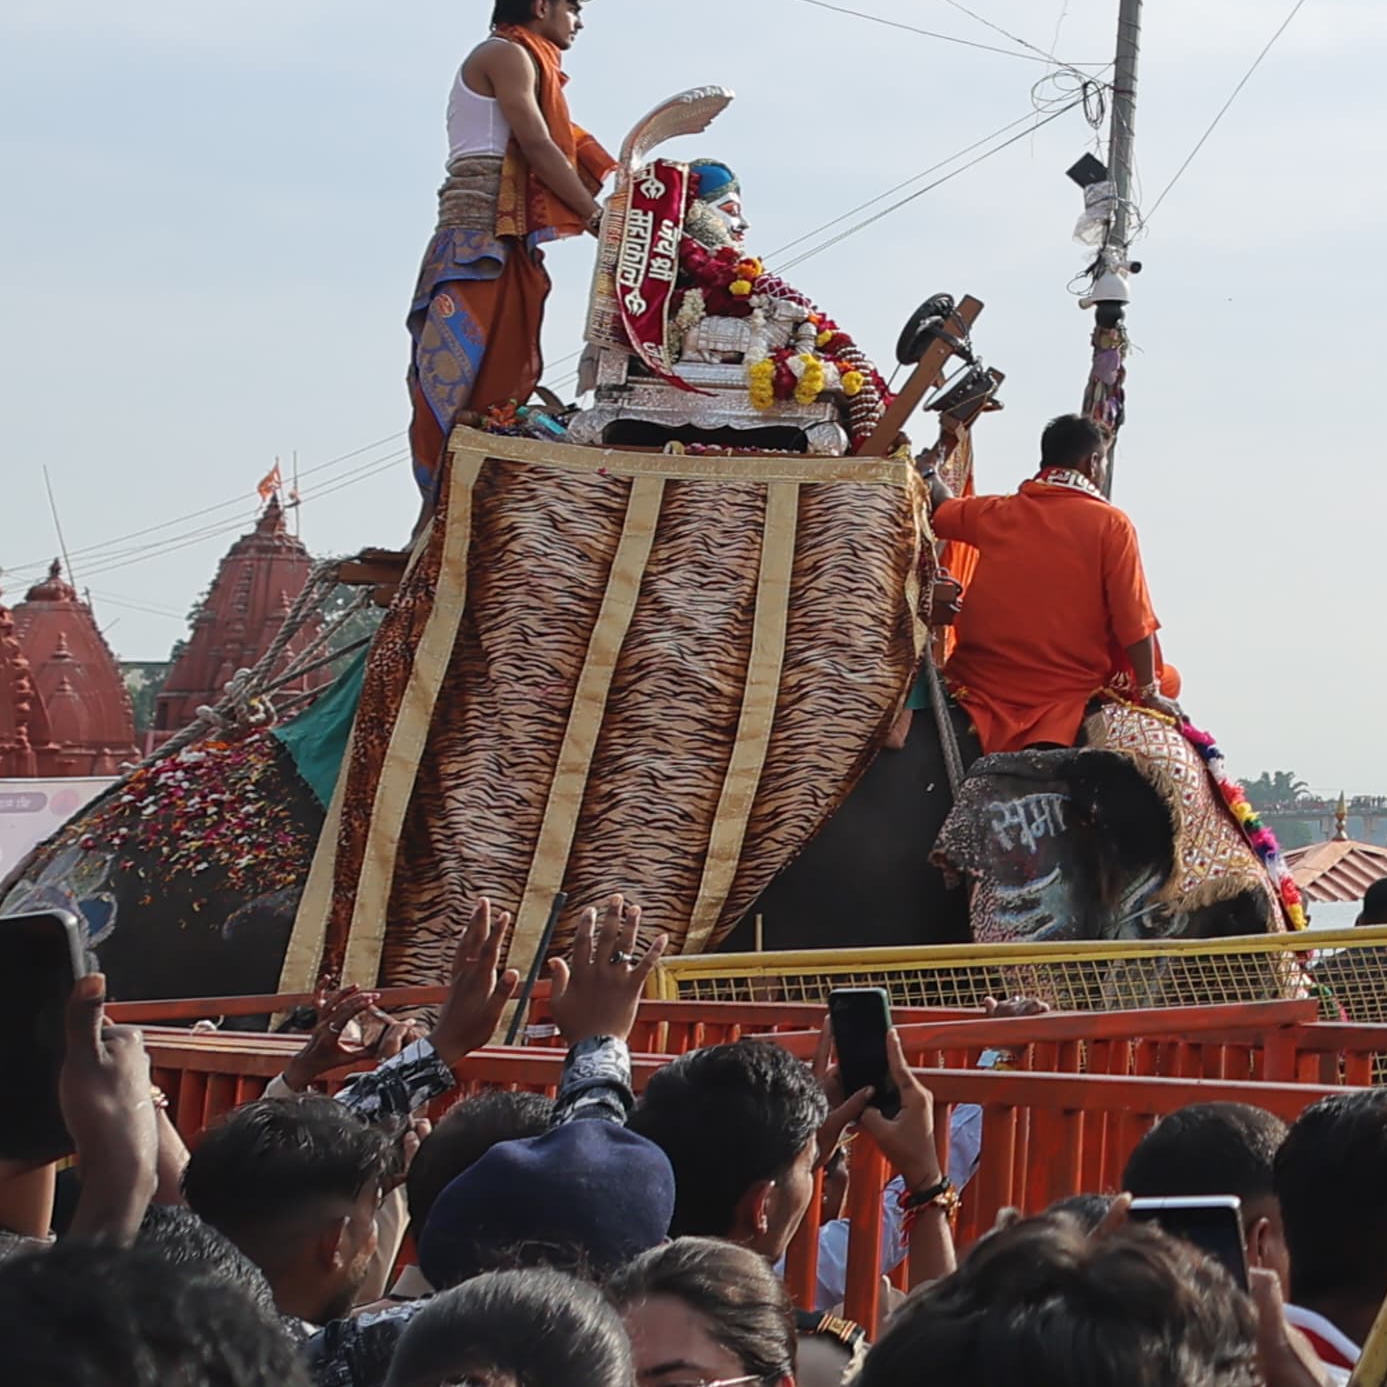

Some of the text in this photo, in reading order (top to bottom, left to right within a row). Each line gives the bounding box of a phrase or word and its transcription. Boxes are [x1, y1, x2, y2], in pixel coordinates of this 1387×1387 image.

[619, 209, 653, 288] महाकाल
[649, 219, 681, 281] जय श्री
